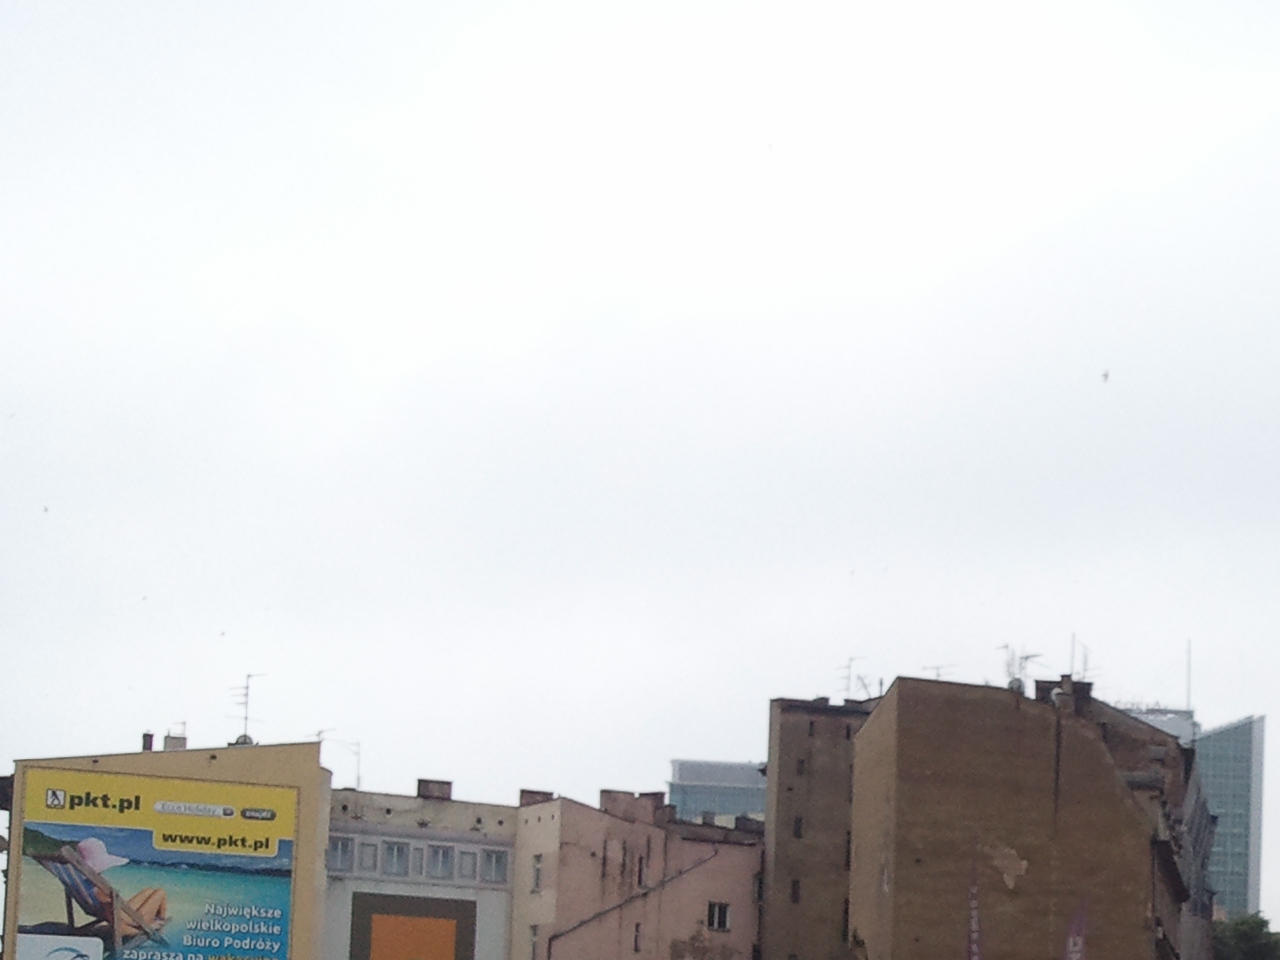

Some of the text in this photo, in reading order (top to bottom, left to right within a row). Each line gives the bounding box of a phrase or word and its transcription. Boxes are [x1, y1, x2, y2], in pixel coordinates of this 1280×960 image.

[69, 791, 141, 814] pkt.pl
[162, 832, 271, 851] www.pkt.pl
[204, 902, 282, 919] Największe
[186, 918, 282, 935] wielkopolskie
[182, 935, 281, 953] Biuro Podróży
